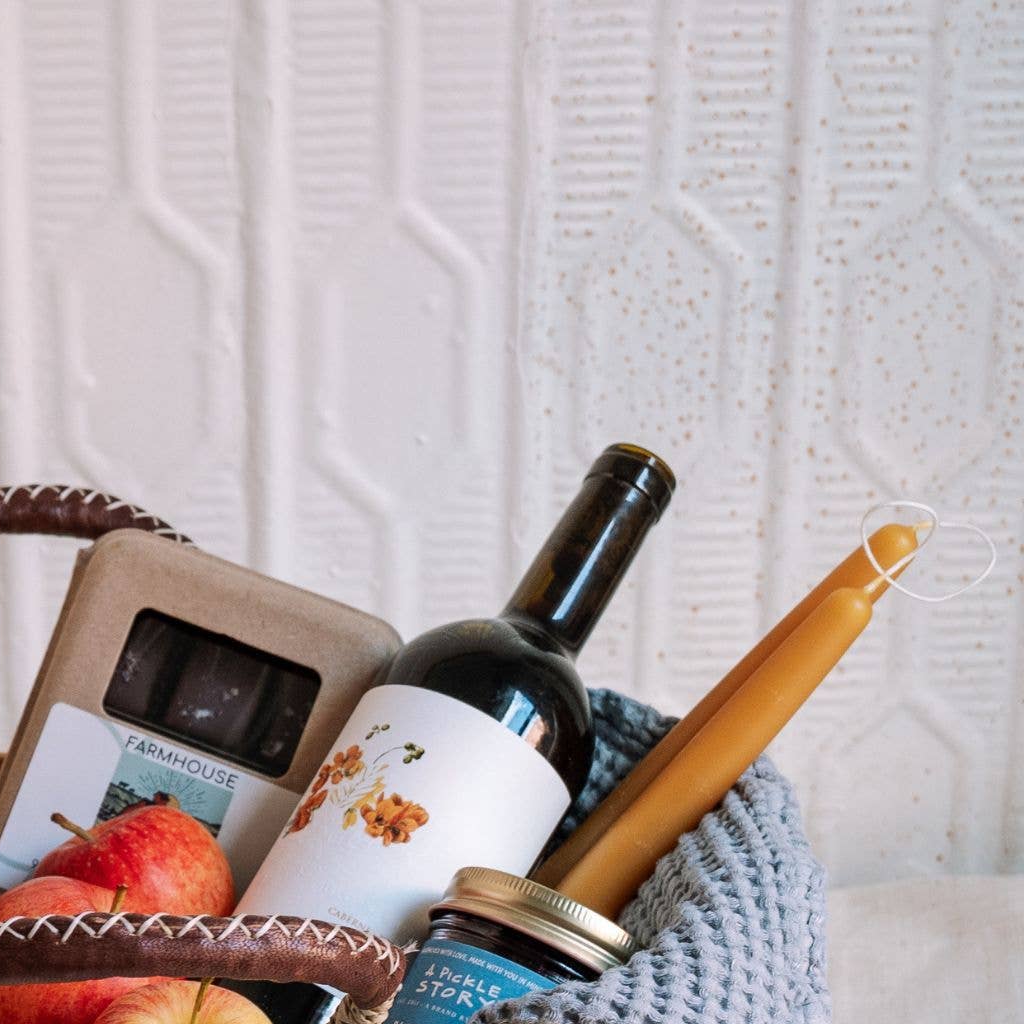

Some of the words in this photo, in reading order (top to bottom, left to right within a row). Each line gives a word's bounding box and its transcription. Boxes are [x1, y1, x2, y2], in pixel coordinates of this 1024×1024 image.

[125, 734, 239, 789] FARMHOUSE
[415, 980, 497, 1008] STORY
[439, 966, 502, 998] PICKLE
